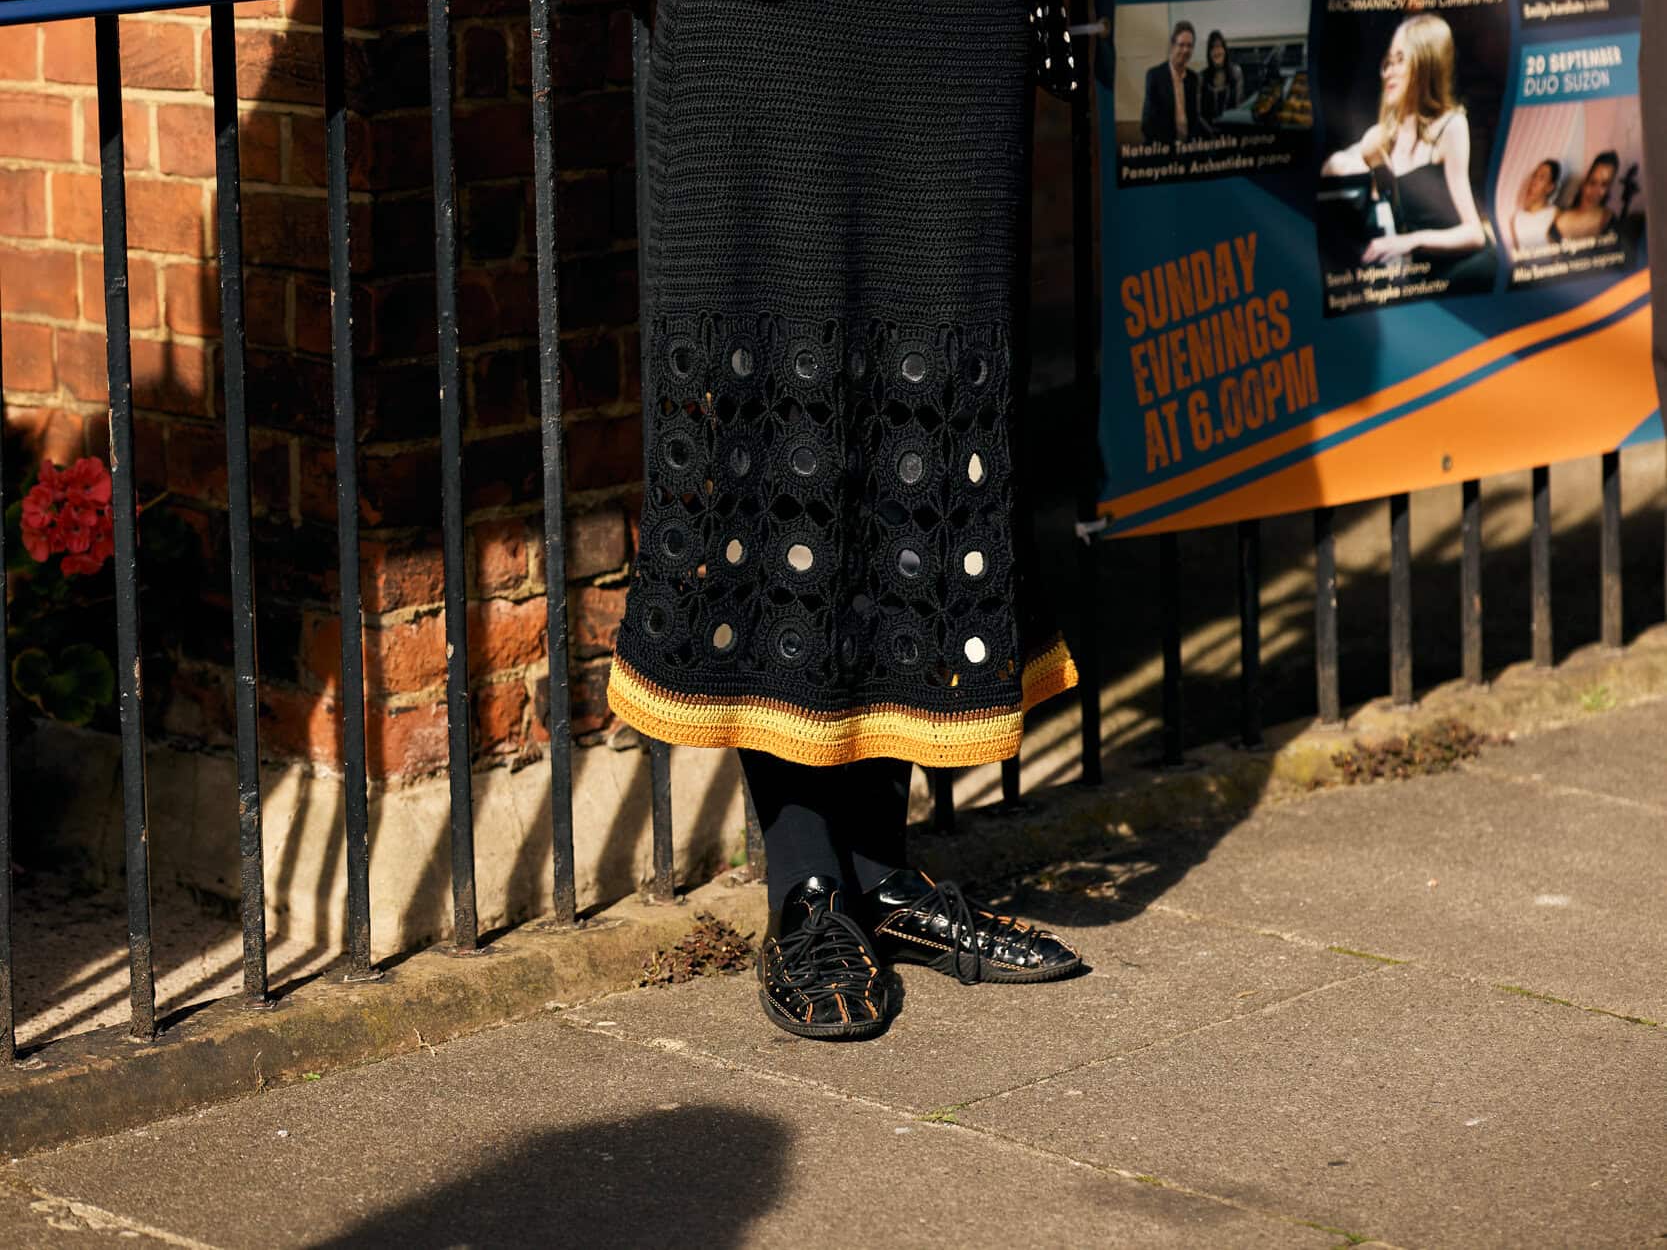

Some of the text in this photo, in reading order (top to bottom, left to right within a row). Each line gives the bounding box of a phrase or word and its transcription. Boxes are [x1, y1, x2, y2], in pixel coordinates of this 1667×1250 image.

[1523, 70, 1610, 97] DUO SUZON
[1526, 45, 1622, 76] 20 SEPTEMBER
[1120, 231, 1257, 338] SUNDAY
[1130, 288, 1292, 406] EVENINGS
[1144, 344, 1319, 474] AT 6.00PM
